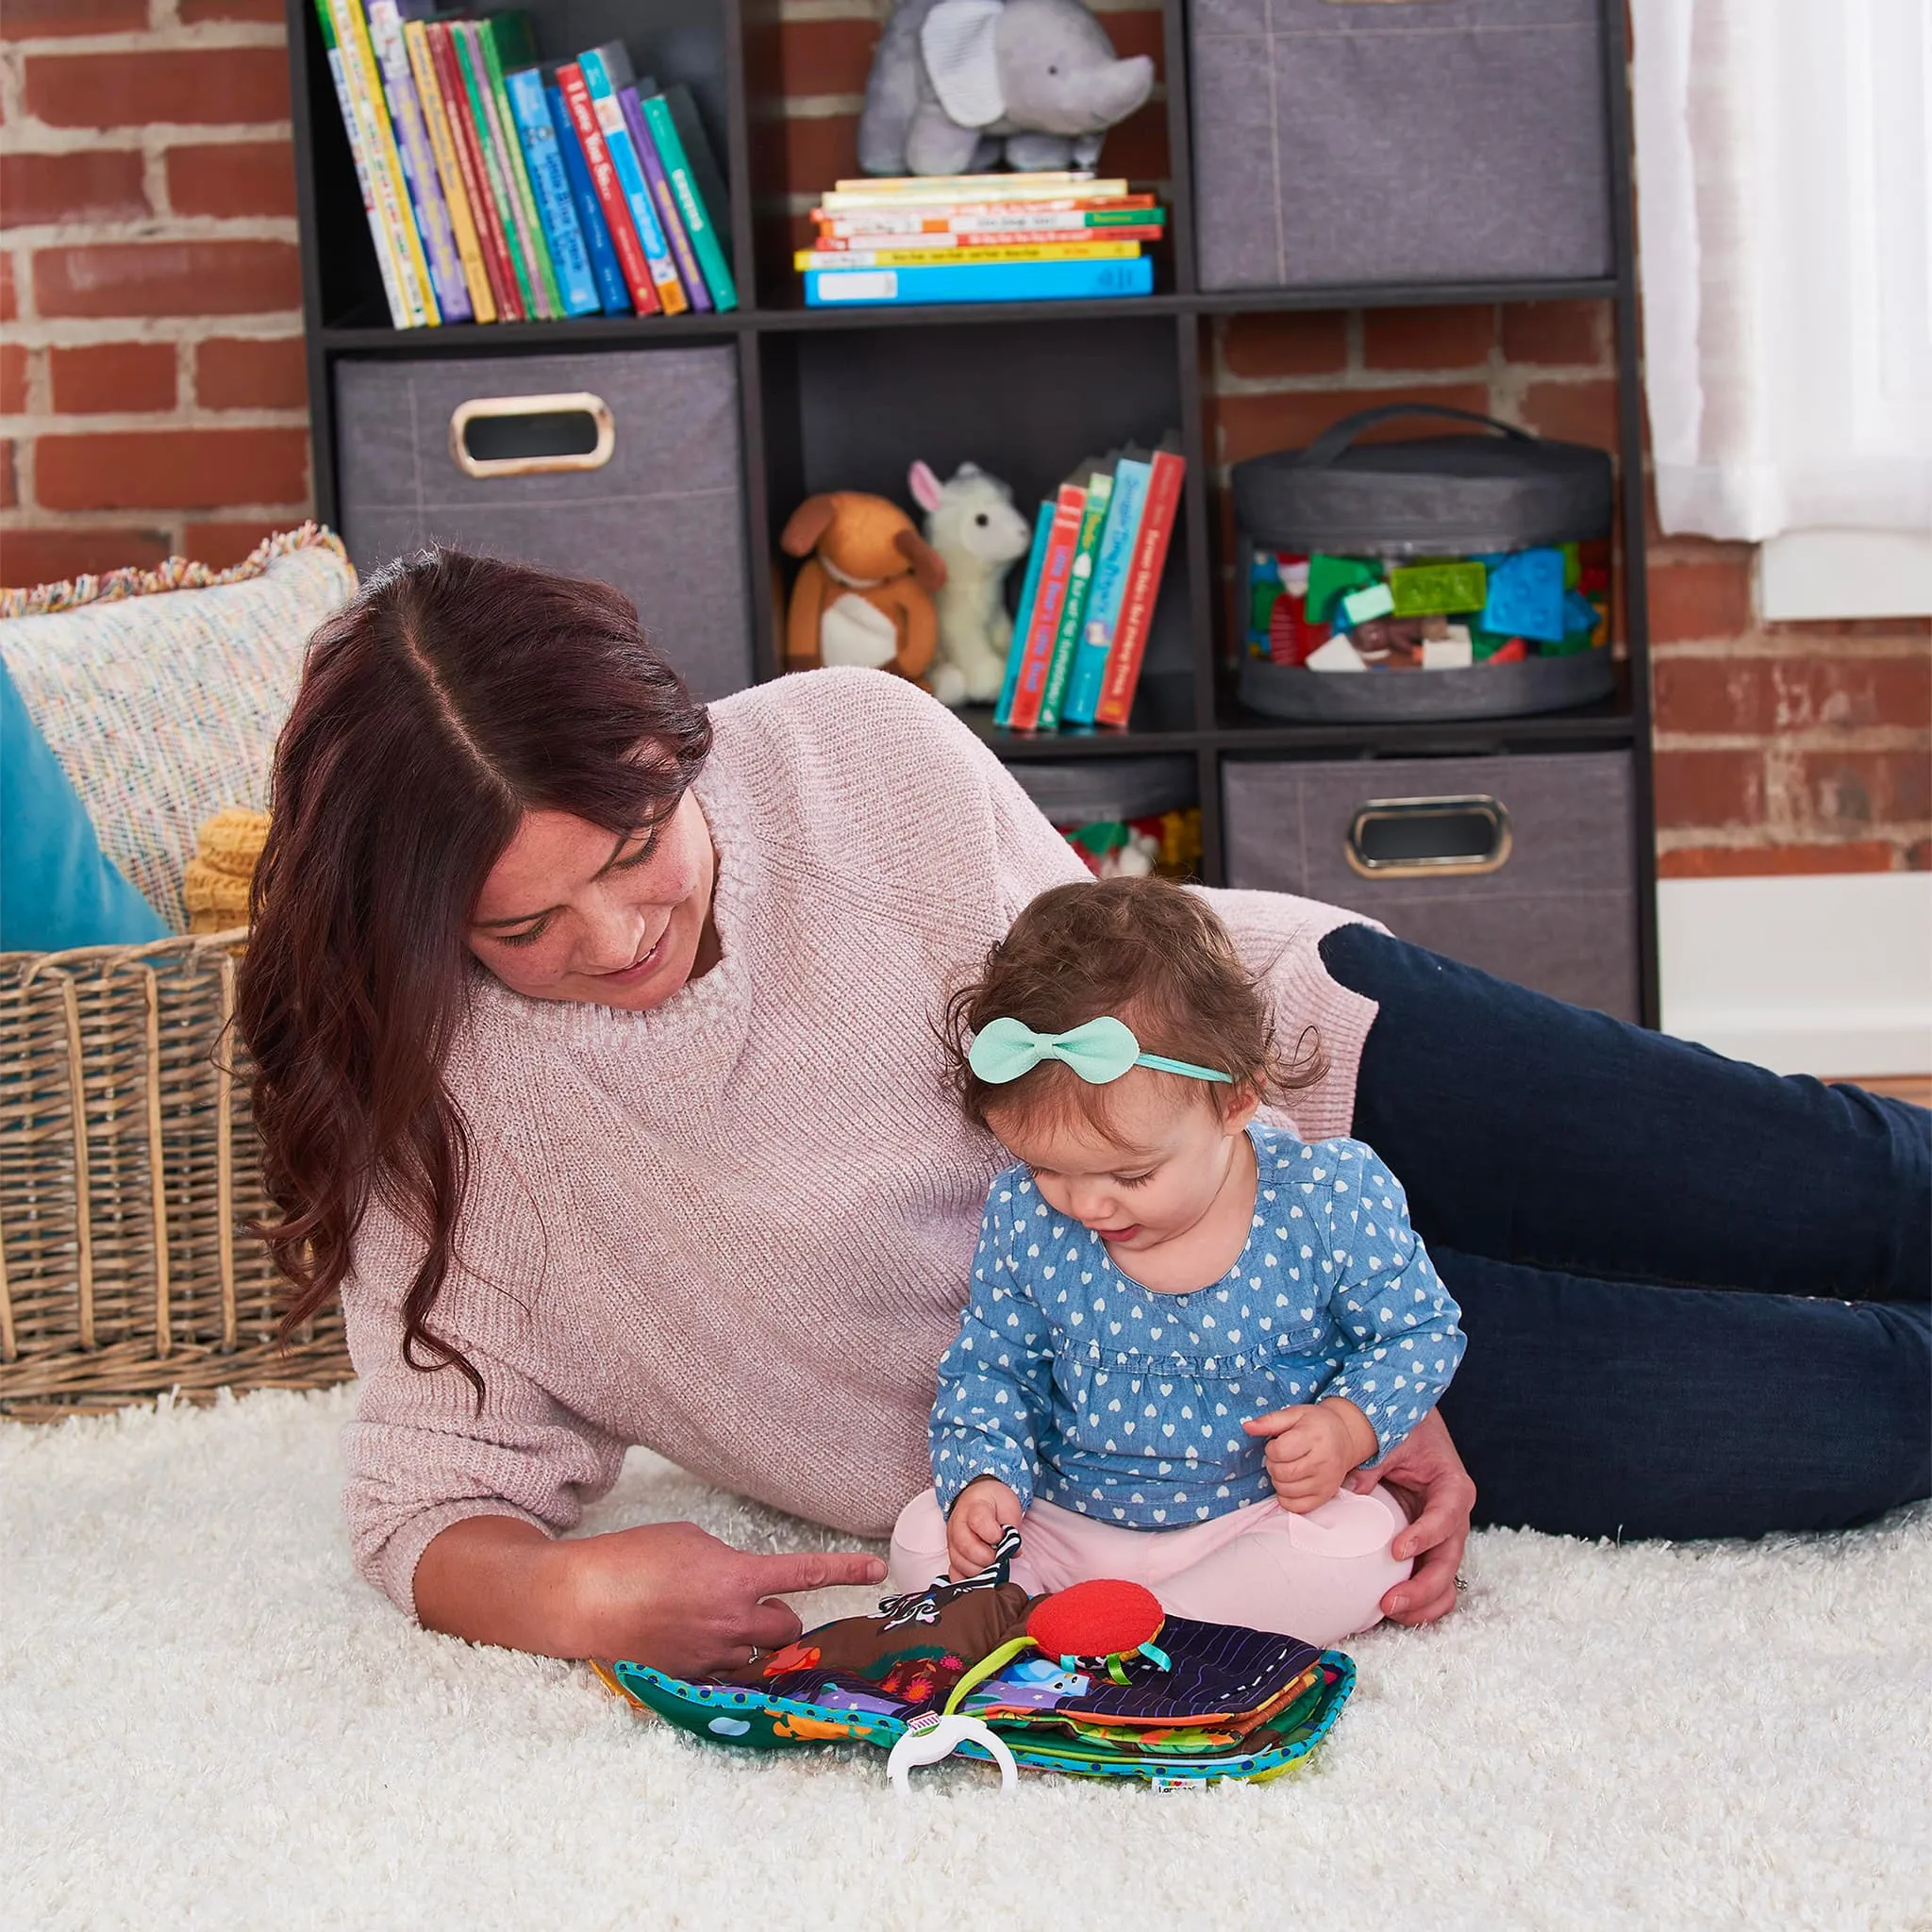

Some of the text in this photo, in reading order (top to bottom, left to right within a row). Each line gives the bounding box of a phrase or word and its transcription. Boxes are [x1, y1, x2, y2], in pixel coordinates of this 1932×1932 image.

[568, 80, 583, 92] I
[569, 91, 598, 133] Love
[582, 130, 608, 164] You
